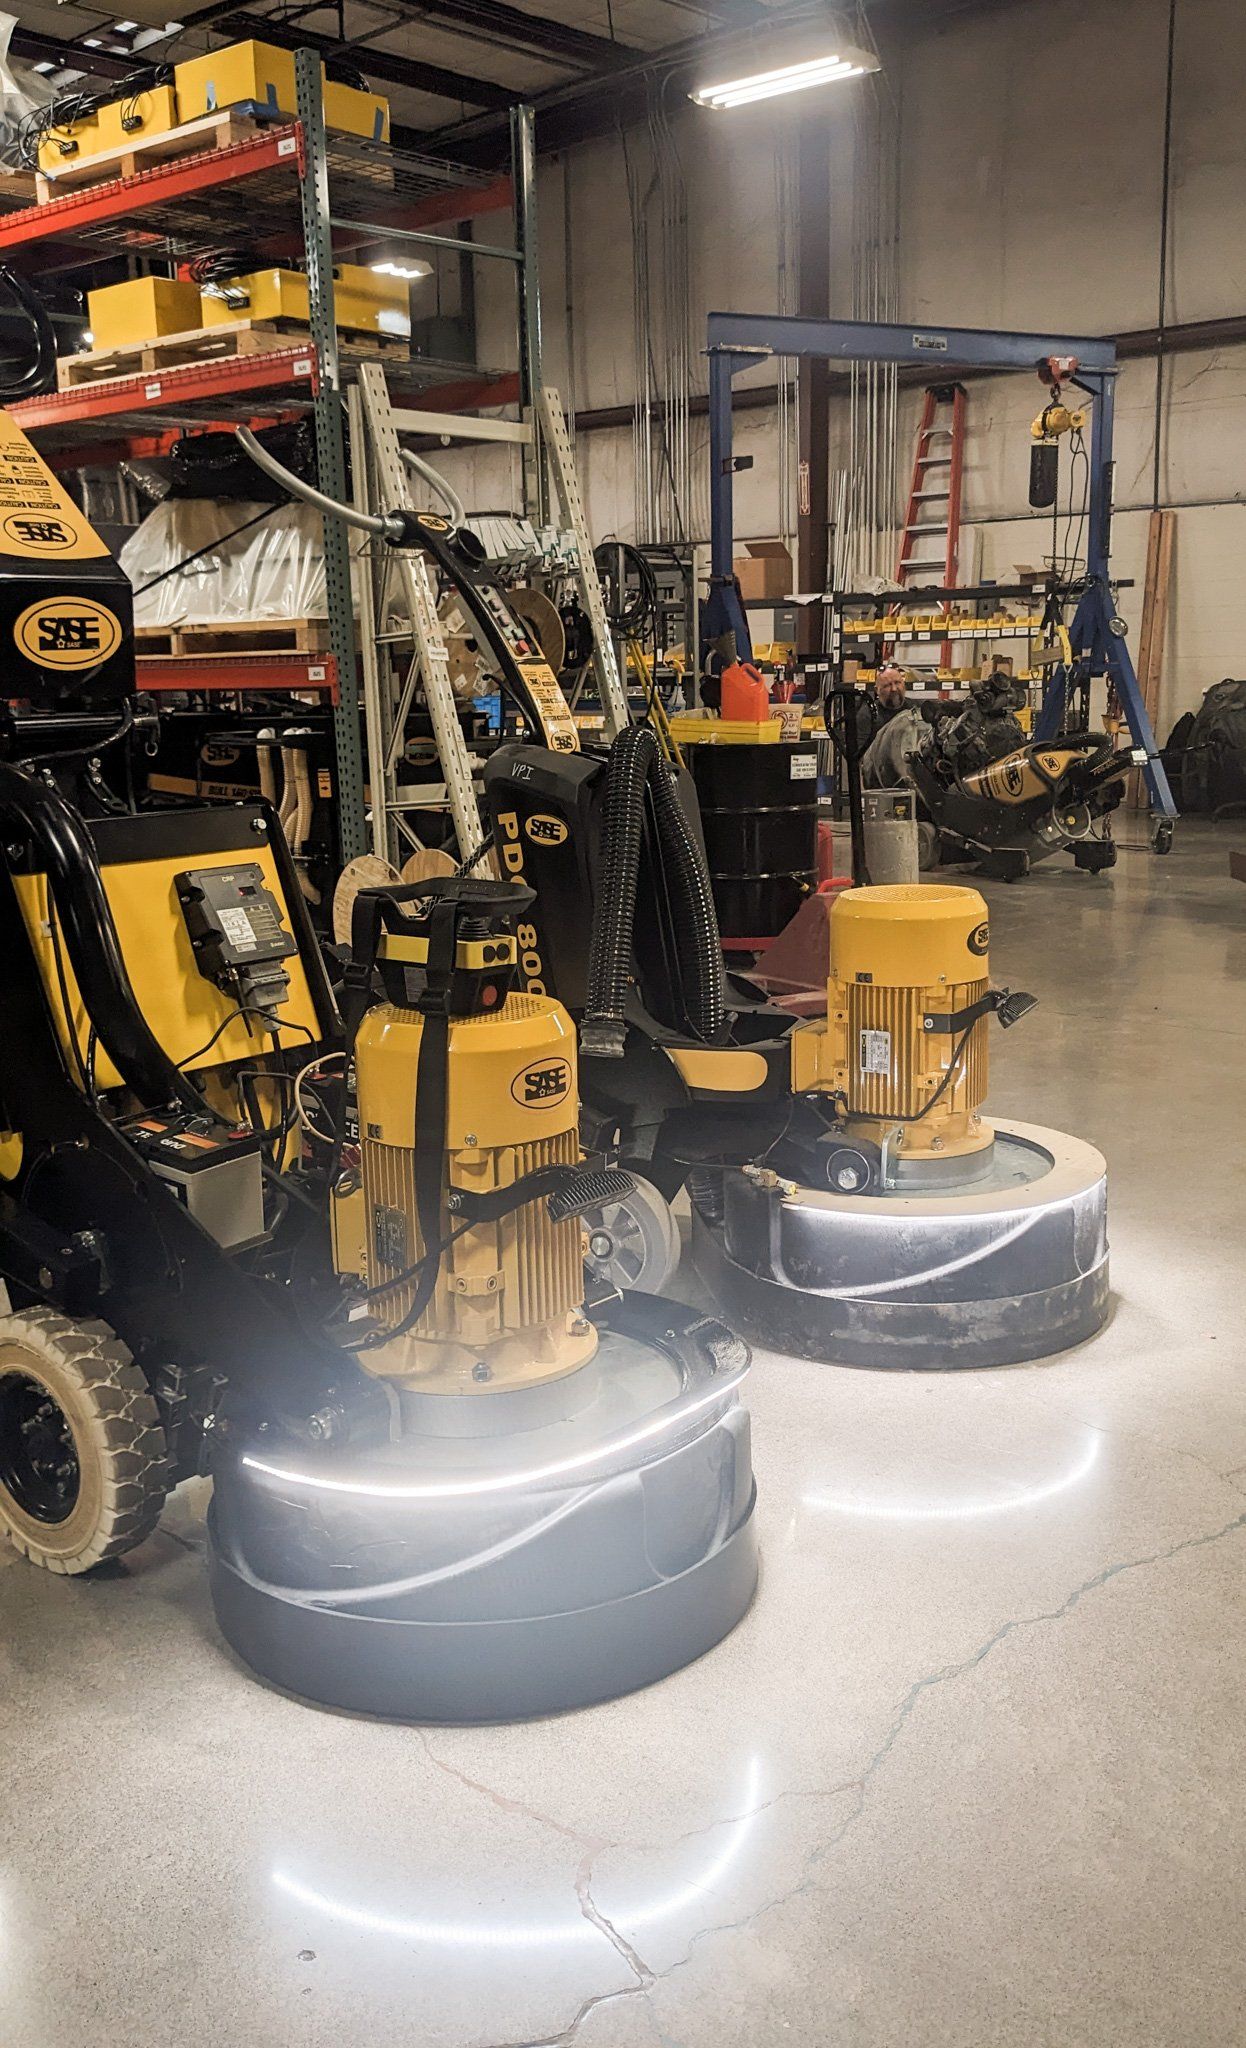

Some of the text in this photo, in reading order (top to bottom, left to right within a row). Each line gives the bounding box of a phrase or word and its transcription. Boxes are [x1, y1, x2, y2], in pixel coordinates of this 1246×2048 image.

[38, 617, 100, 651] SASE
[530, 818, 561, 841] SASE
[525, 1065, 567, 1101] SASE
